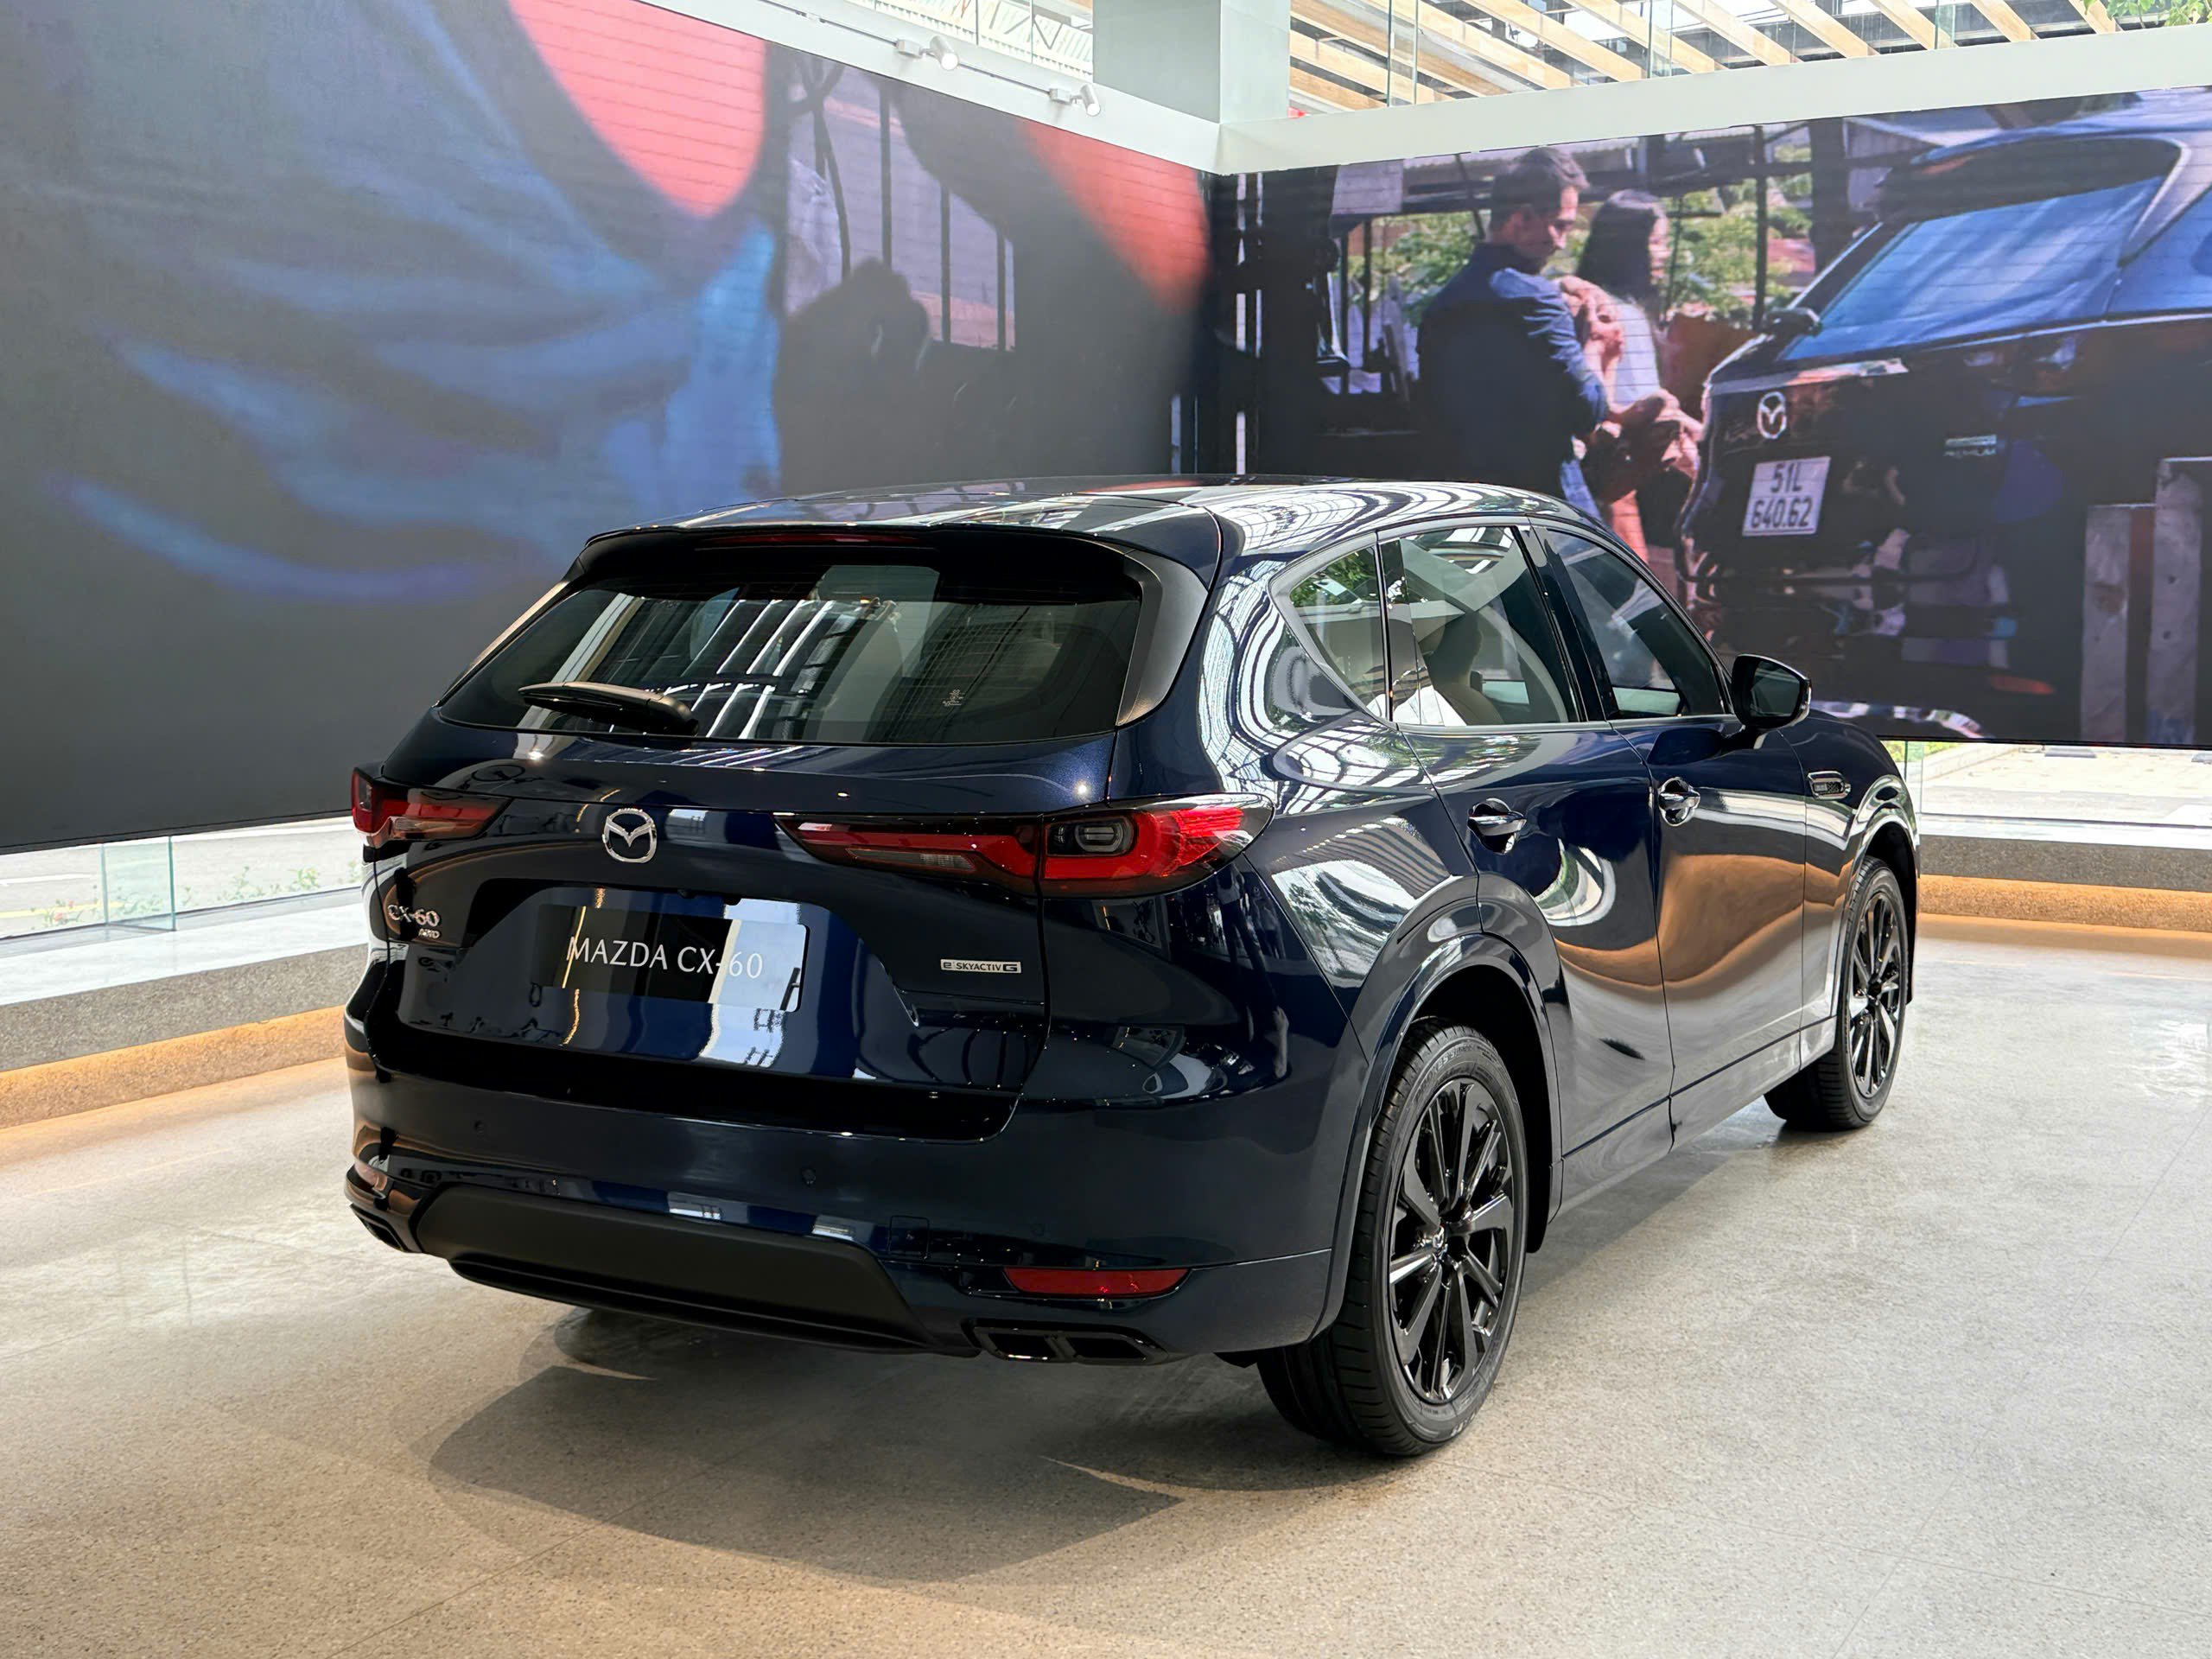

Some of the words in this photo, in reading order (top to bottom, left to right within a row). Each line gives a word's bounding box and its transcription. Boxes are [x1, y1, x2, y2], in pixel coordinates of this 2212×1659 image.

[1771, 461, 1802, 493] 51L
[1751, 497, 1812, 529] 640.62
[387, 904, 440, 927] CX-60
[566, 936, 669, 970] MAZDA
[677, 946, 763, 979] CX-60
